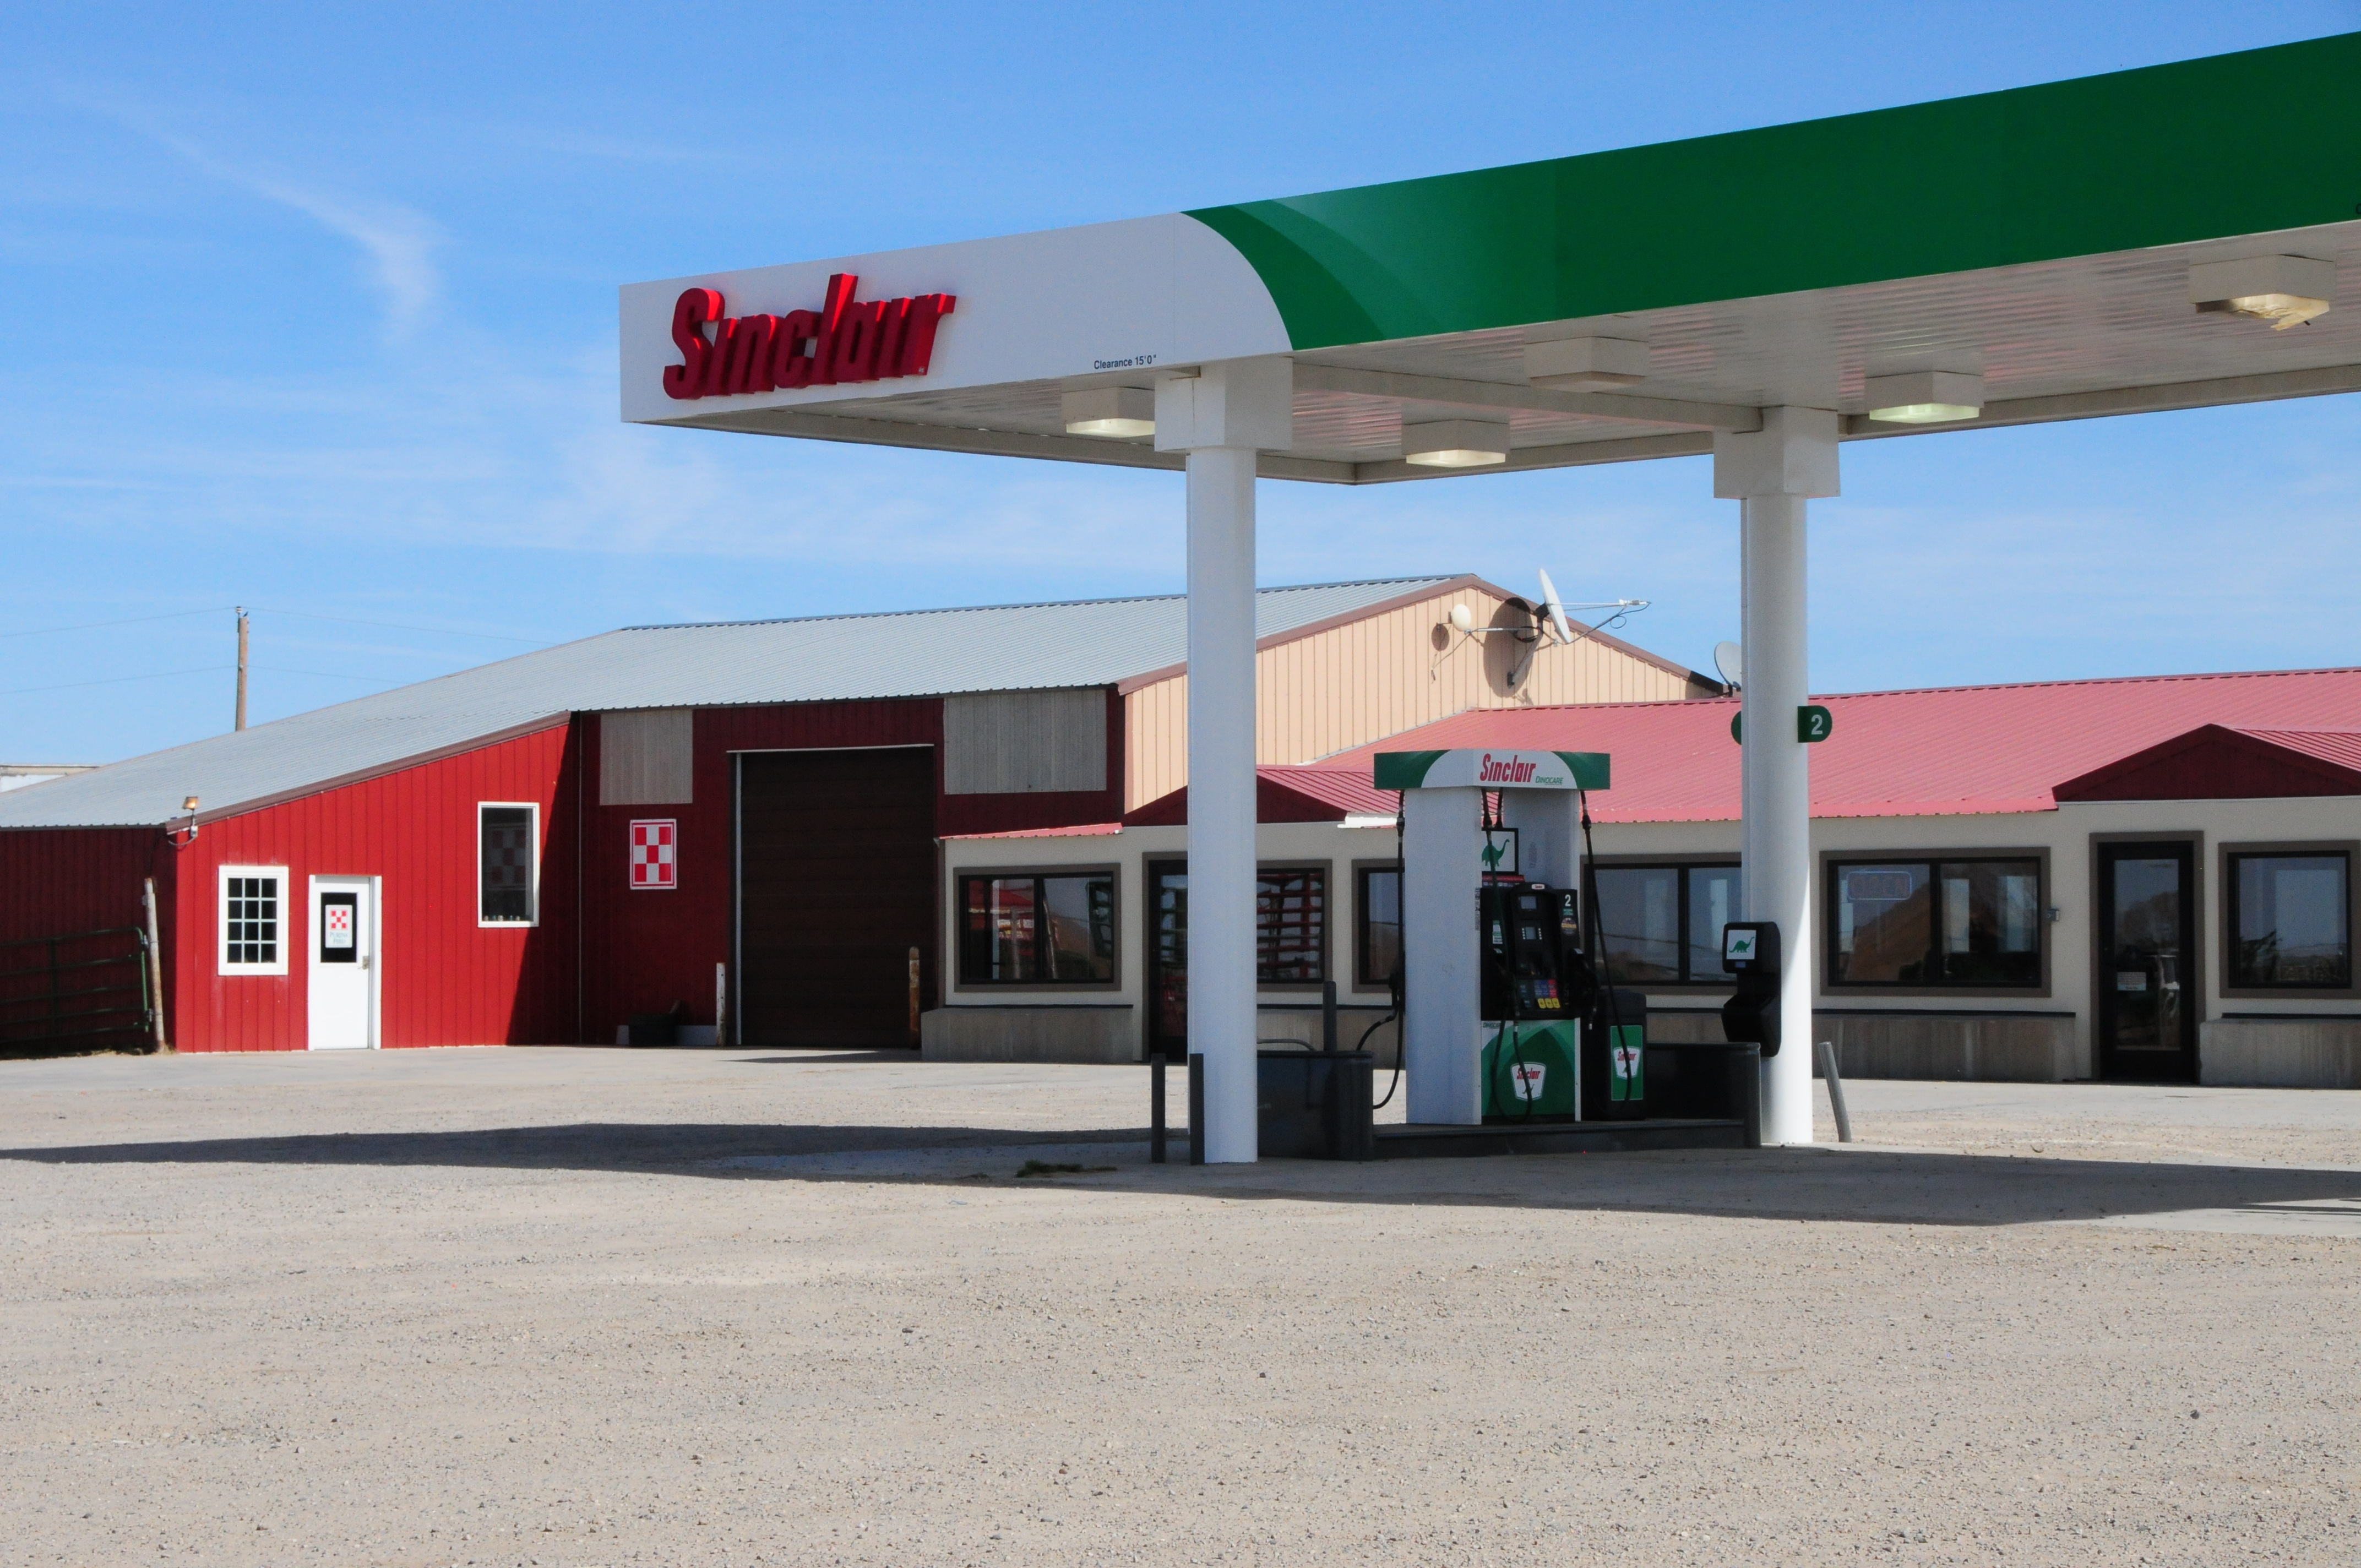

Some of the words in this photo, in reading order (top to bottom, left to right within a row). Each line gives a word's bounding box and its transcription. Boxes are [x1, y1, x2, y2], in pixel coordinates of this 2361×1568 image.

[662, 273, 956, 400] Sinclair
[1094, 359, 1133, 369] Clearance
[1811, 714, 1823, 735] 2
[1479, 753, 1536, 783] Sinclair
[1565, 894, 1571, 907] 2
